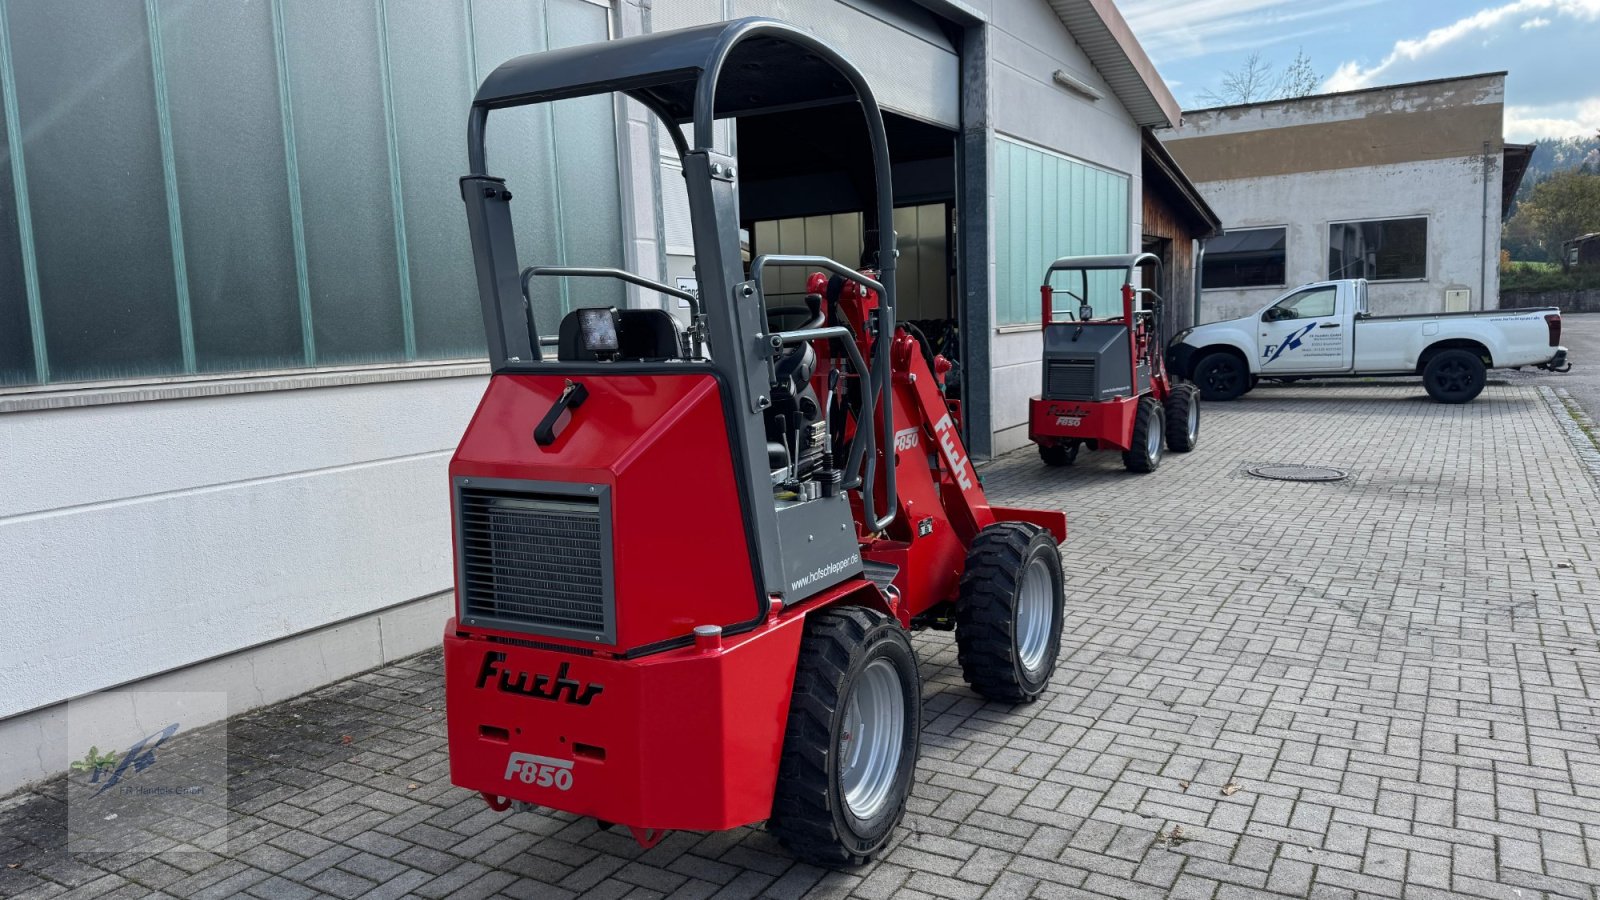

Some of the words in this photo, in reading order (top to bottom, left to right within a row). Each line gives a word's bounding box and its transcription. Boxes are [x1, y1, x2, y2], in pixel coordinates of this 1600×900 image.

[893, 426, 920, 453] F850
[1056, 416, 1082, 427] F850
[791, 553, 859, 591] www.hofschlepper.de
[475, 650, 604, 706] Fuchs
[504, 751, 575, 791] F850
